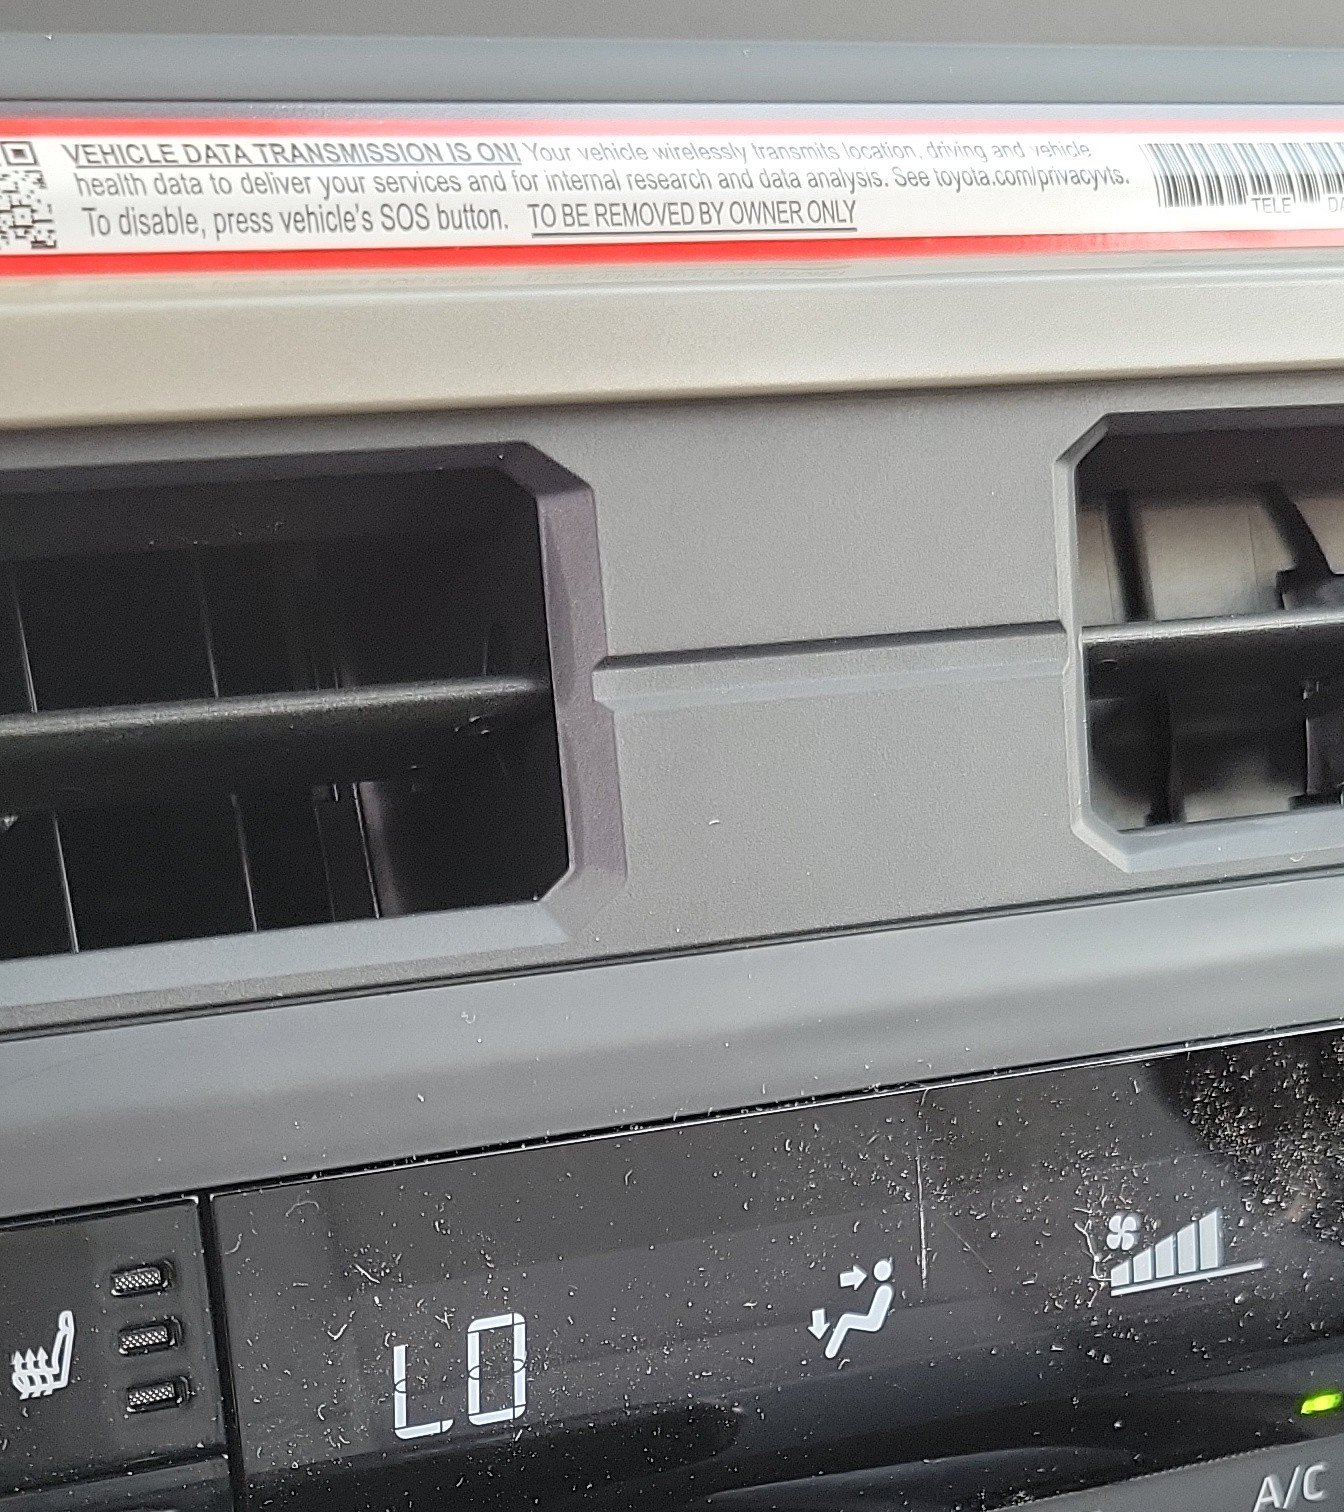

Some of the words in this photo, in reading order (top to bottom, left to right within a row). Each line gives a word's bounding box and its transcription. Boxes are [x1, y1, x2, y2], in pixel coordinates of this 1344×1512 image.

[62, 143, 176, 166] VEHICLE
[183, 143, 253, 165] DATA
[255, 143, 443, 164] TRANSMISSION
[446, 143, 471, 163] IS
[477, 142, 521, 163] ON!
[522, 142, 571, 161] Your
[577, 142, 648, 161] vehicle
[653, 142, 747, 164] wirelessly
[754, 141, 841, 160] transmits
[843, 141, 923, 162] location,
[926, 141, 988, 163] driving
[992, 141, 1025, 159] and
[1030, 141, 1092, 158] vehicle
[74, 172, 147, 197] health
[155, 172, 204, 196] data
[210, 174, 231, 196] to
[240, 171, 314, 196] deliver
[320, 175, 365, 201] your
[374, 171, 461, 195] services
[469, 170, 506, 193] and
[511, 169, 539, 192] for
[544, 169, 620, 192] internal
[627, 168, 712, 191] research
[719, 168, 754, 190] and
[760, 167, 802, 189] data
[808, 167, 889, 194] analysis.
[892, 166, 931, 187] See
[935, 165, 1130, 193] toyota.com/privacyvts.
[81, 206, 110, 237] To
[119, 204, 207, 239] disable,
[214, 209, 273, 240] press
[279, 203, 373, 234] vehicle's
[381, 202, 430, 233] SOS
[437, 201, 509, 232] button.
[526, 203, 556, 229] TO
[562, 203, 590, 228] BE
[594, 202, 695, 228] REMOVED
[698, 201, 724, 227] BY
[729, 200, 804, 226] OWNER
[807, 199, 856, 224] ONLY
[1250, 197, 1292, 214] TELE
[392, 1311, 527, 1441] LO
